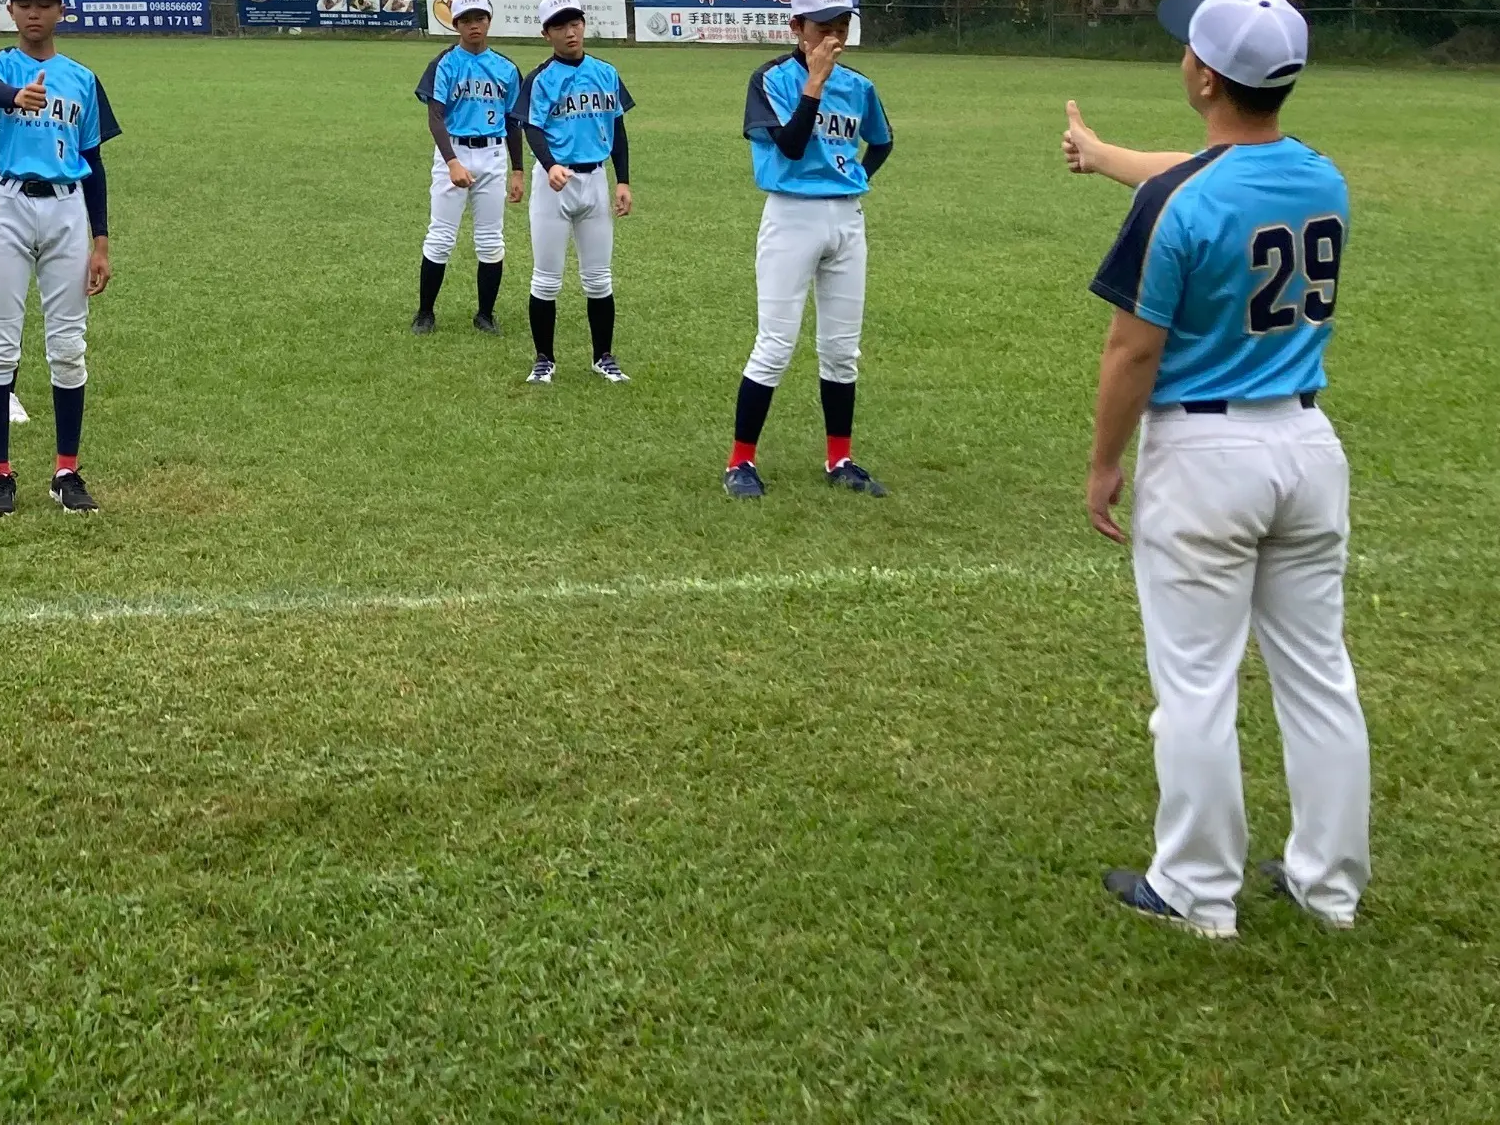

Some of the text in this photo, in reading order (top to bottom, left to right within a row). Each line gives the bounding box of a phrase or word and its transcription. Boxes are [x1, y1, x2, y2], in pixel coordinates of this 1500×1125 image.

[149, 2, 202, 12] 0988566692
[452, 80, 506, 100] JAPAN
[550, 92, 616, 117] JAPAN
[487, 110, 496, 125] 2
[815, 111, 859, 140] PAN
[1248, 214, 1345, 336] 29
